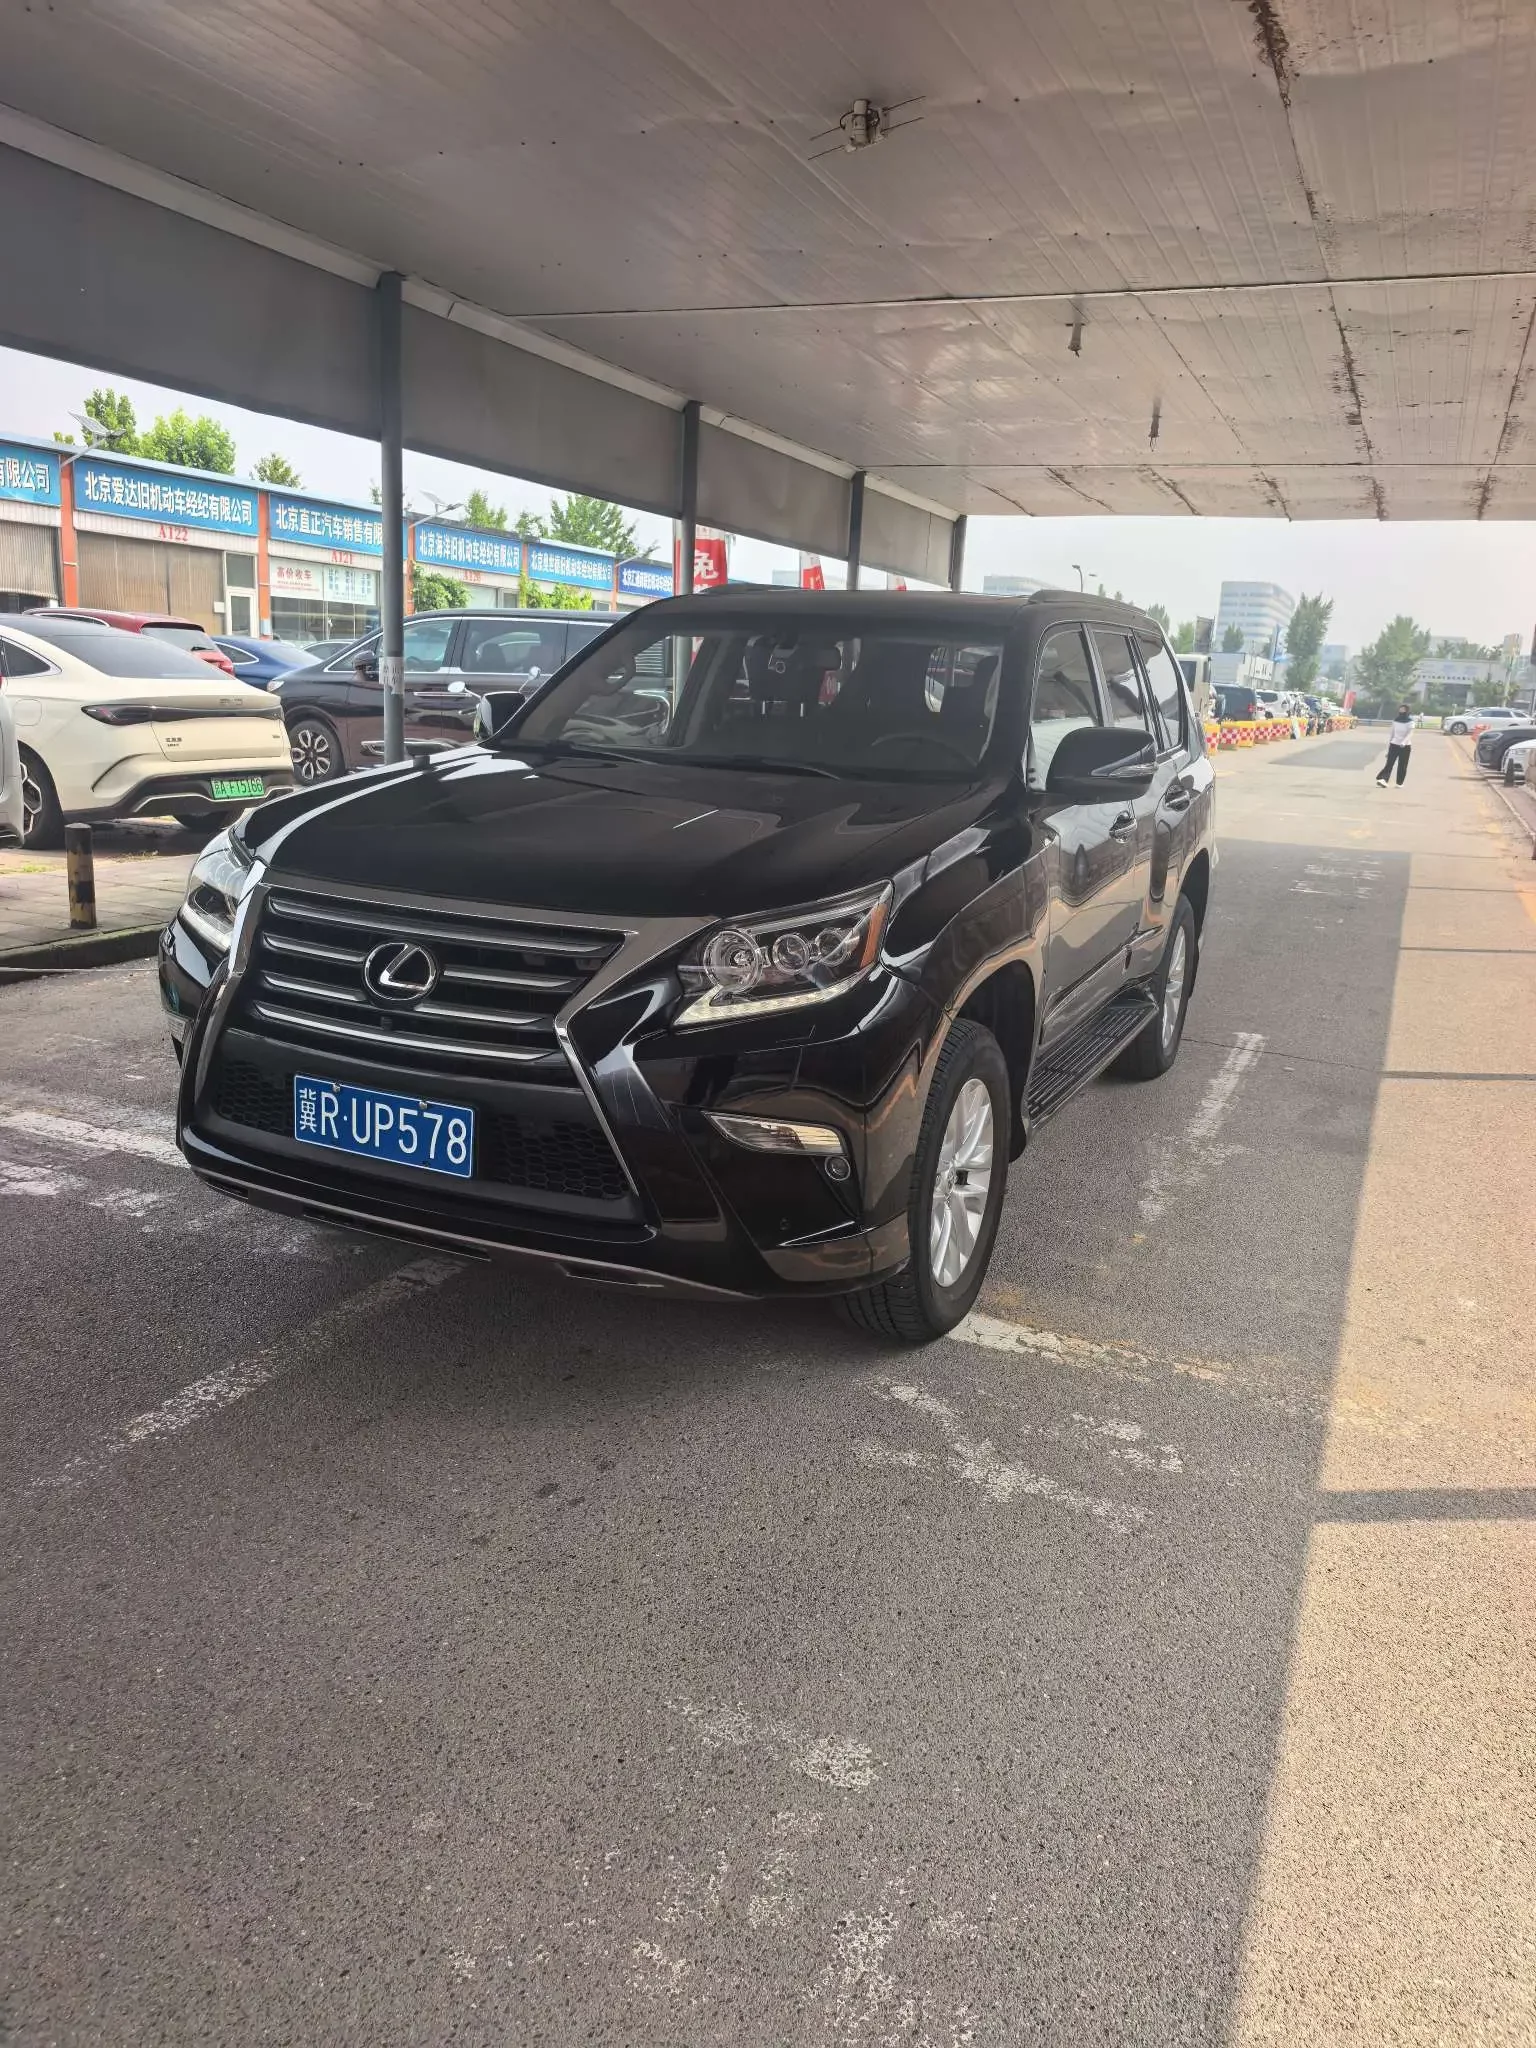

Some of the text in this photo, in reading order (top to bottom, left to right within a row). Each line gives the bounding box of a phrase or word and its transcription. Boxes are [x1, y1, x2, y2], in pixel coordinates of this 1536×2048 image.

[85, 471, 252, 526] 北京爱达旧机动车经纪有限公司
[159, 525, 189, 542] A122
[331, 549, 354, 565] A121
[694, 549, 718, 592] 免
[299, 1088, 467, 1164] 冀R·UP578
